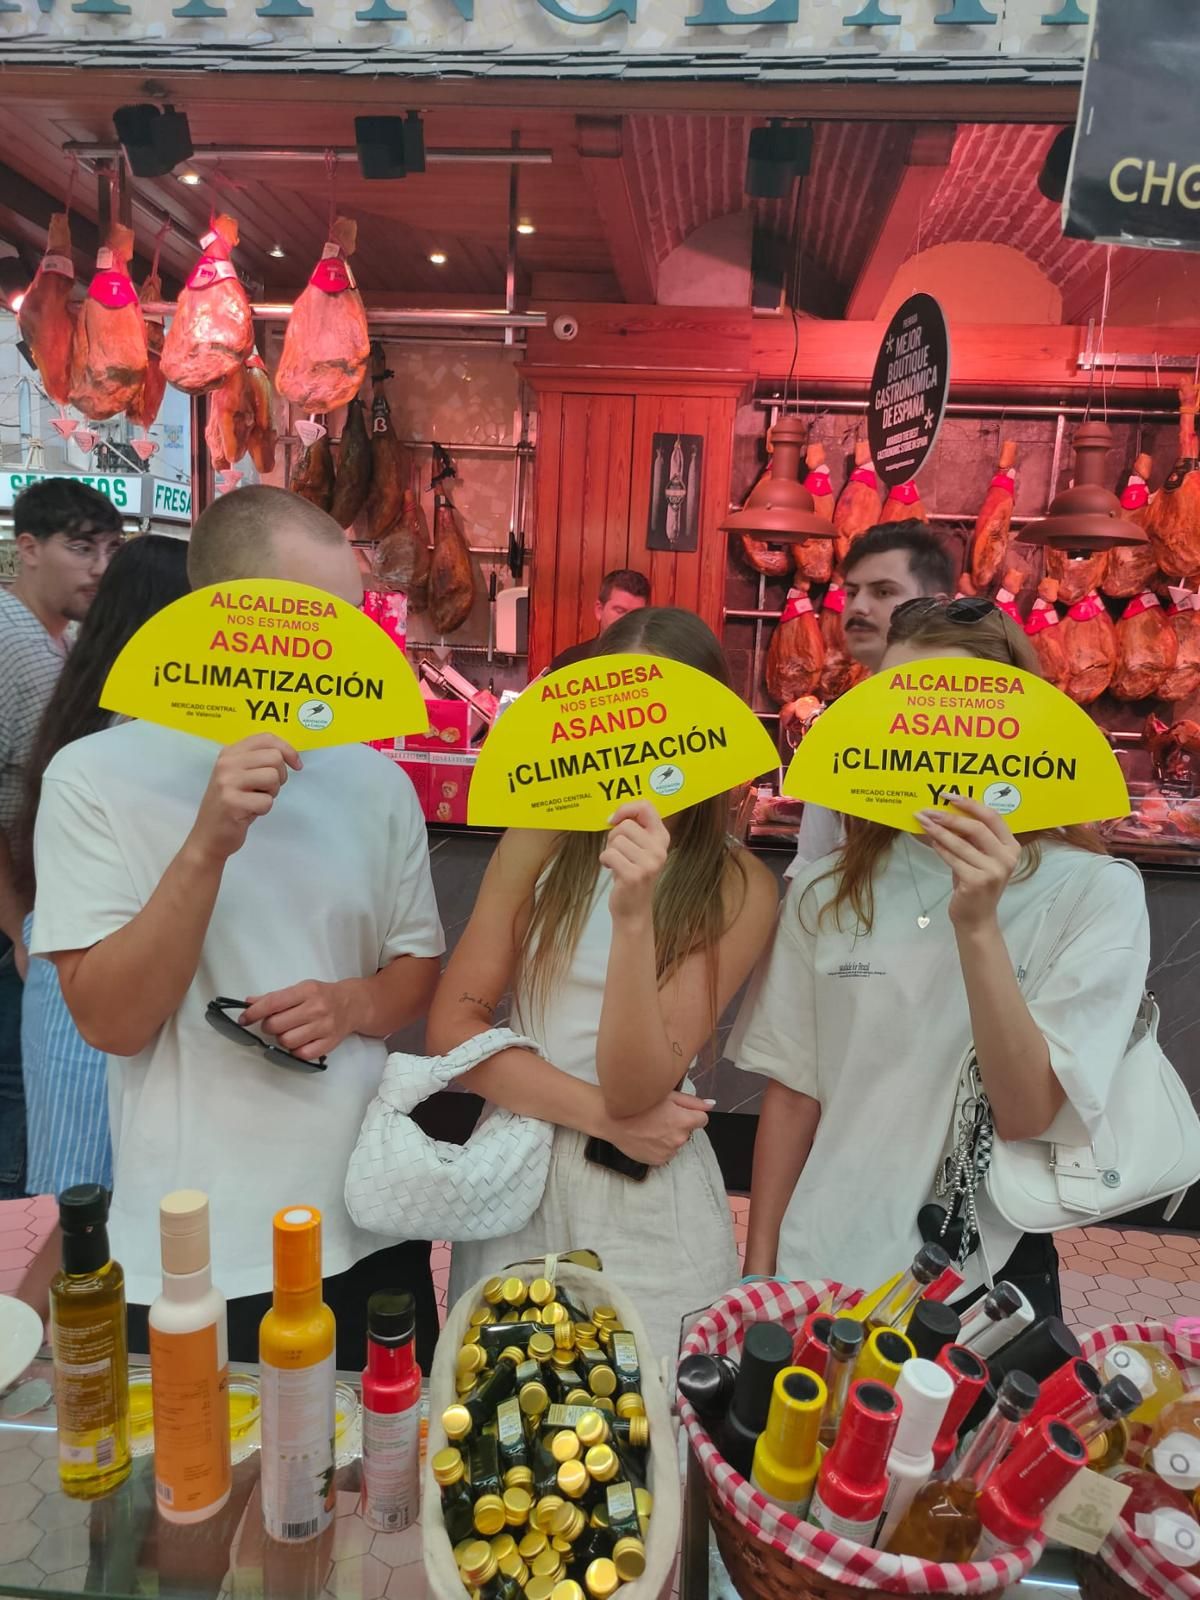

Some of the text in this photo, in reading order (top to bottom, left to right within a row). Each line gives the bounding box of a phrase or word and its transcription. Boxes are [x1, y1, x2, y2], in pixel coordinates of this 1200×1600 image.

[895, 327, 922, 357] MEJOR
[887, 345, 929, 382] BOUTIQUE
[882, 393, 925, 429] DE ESPAÑA
[210, 592, 338, 618] ALCALDESA
[227, 615, 319, 631] NOS ESTAMOS
[209, 630, 333, 660] ASANDO
[153, 662, 383, 699] ¡CLIMATIZACIÓN
[541, 664, 663, 701] ALCALDESA
[889, 673, 1024, 694] ALCALDESA
[171, 701, 236, 712] MERCADO CENTRAL
[246, 699, 289, 723] YA!
[560, 688, 648, 713] NOS ESTAMOS
[907, 696, 1005, 709] NOS ESTAMOS
[551, 702, 667, 743] ASANDO
[889, 713, 1020, 740] ASANDO
[507, 726, 727, 793] ¡CLIMATIZACIÓN
[833, 747, 1076, 780] ¡CLIMATIZACIÓN
[531, 793, 592, 808] MERCADO CENTRAL
[598, 775, 642, 801] YA!
[851, 788, 885, 796] MERCADO
[555, 803, 579, 811] Valencia
